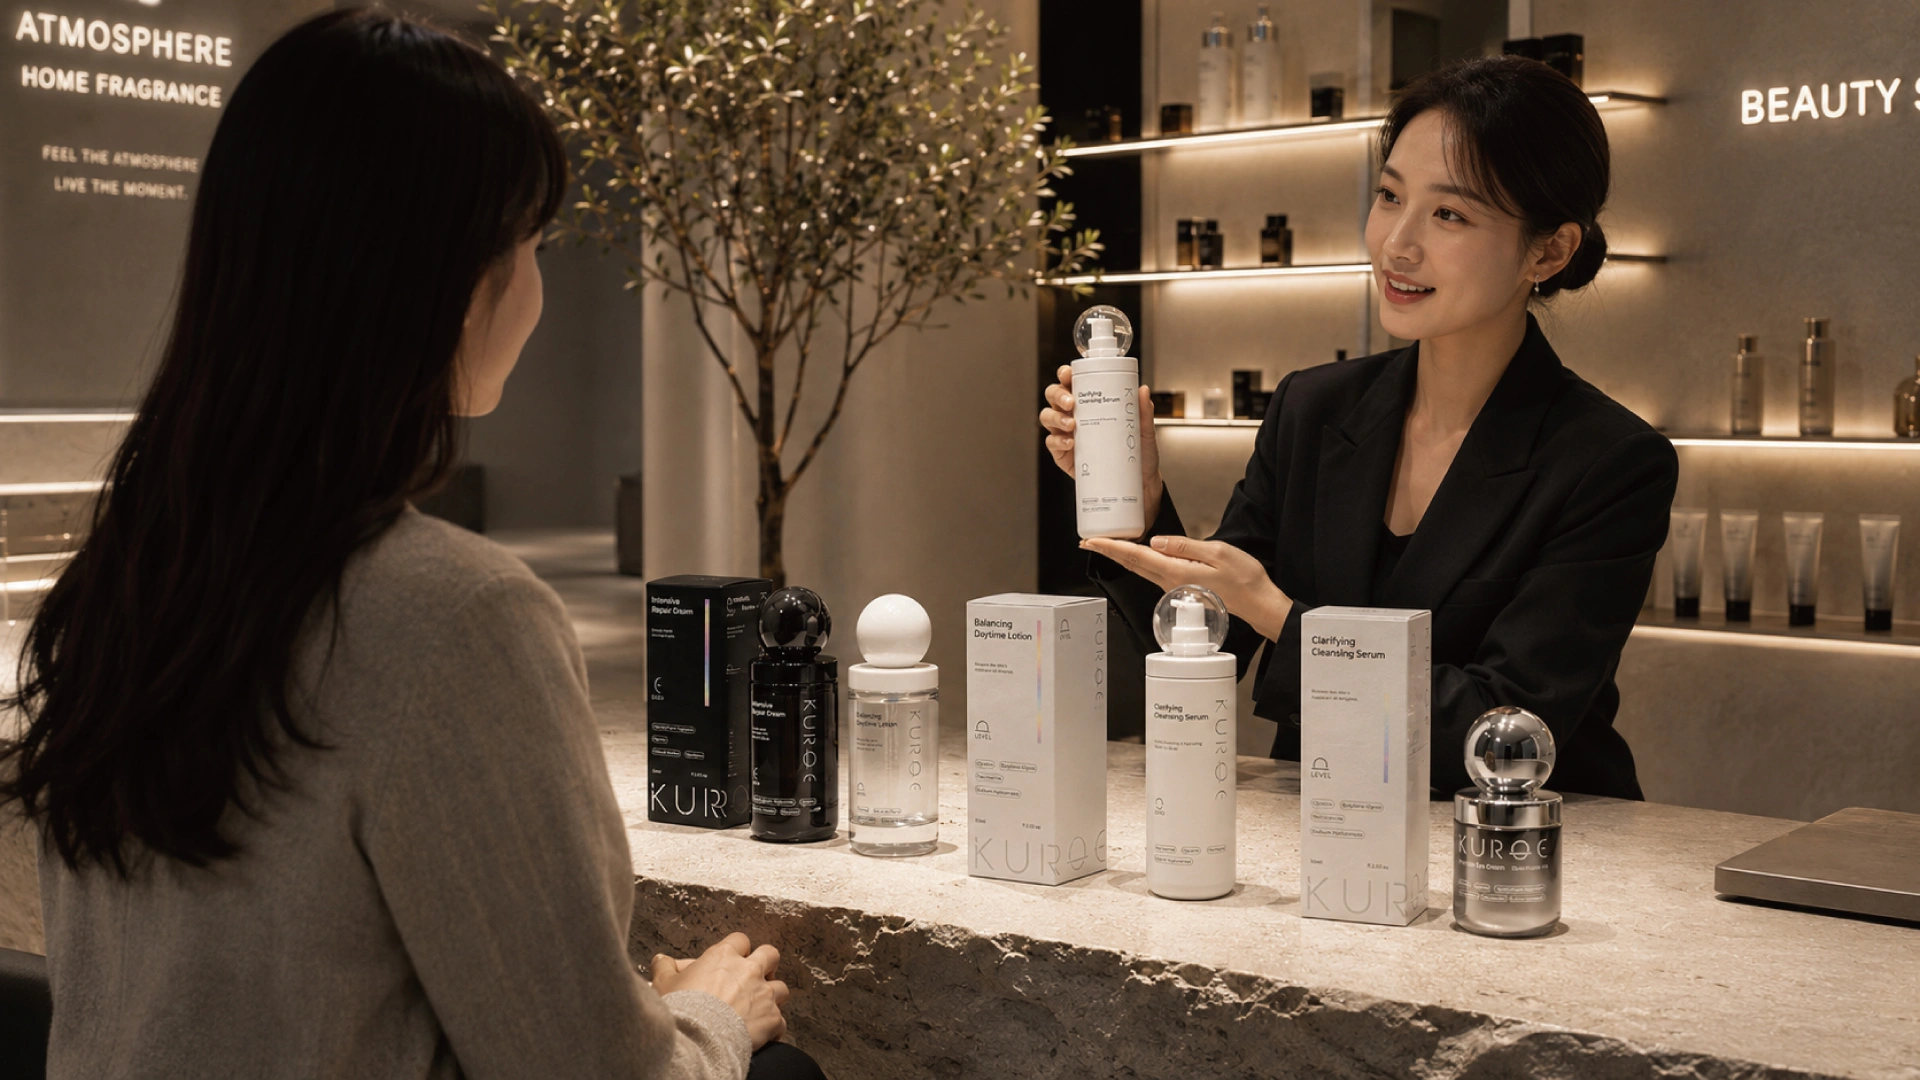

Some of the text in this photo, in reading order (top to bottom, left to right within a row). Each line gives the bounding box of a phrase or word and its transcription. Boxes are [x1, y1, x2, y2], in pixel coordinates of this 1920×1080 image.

[15, 10, 233, 67] ATMOSPHERE
[21, 65, 222, 108] HOME FRAGRANCE
[1741, 77, 1901, 125] BEAUTY
[42, 145, 199, 173] FEEL THE ATMOSPHERE
[54, 176, 87, 194] LIVE
[91, 178, 119, 196] THE
[974, 618, 1013, 629] Balancing
[1008, 632, 1033, 641] Lotion
[1311, 635, 1356, 648] Clarifying
[1311, 647, 1386, 660] Cleansing Serum
[1311, 771, 1331, 779] LEVEL
